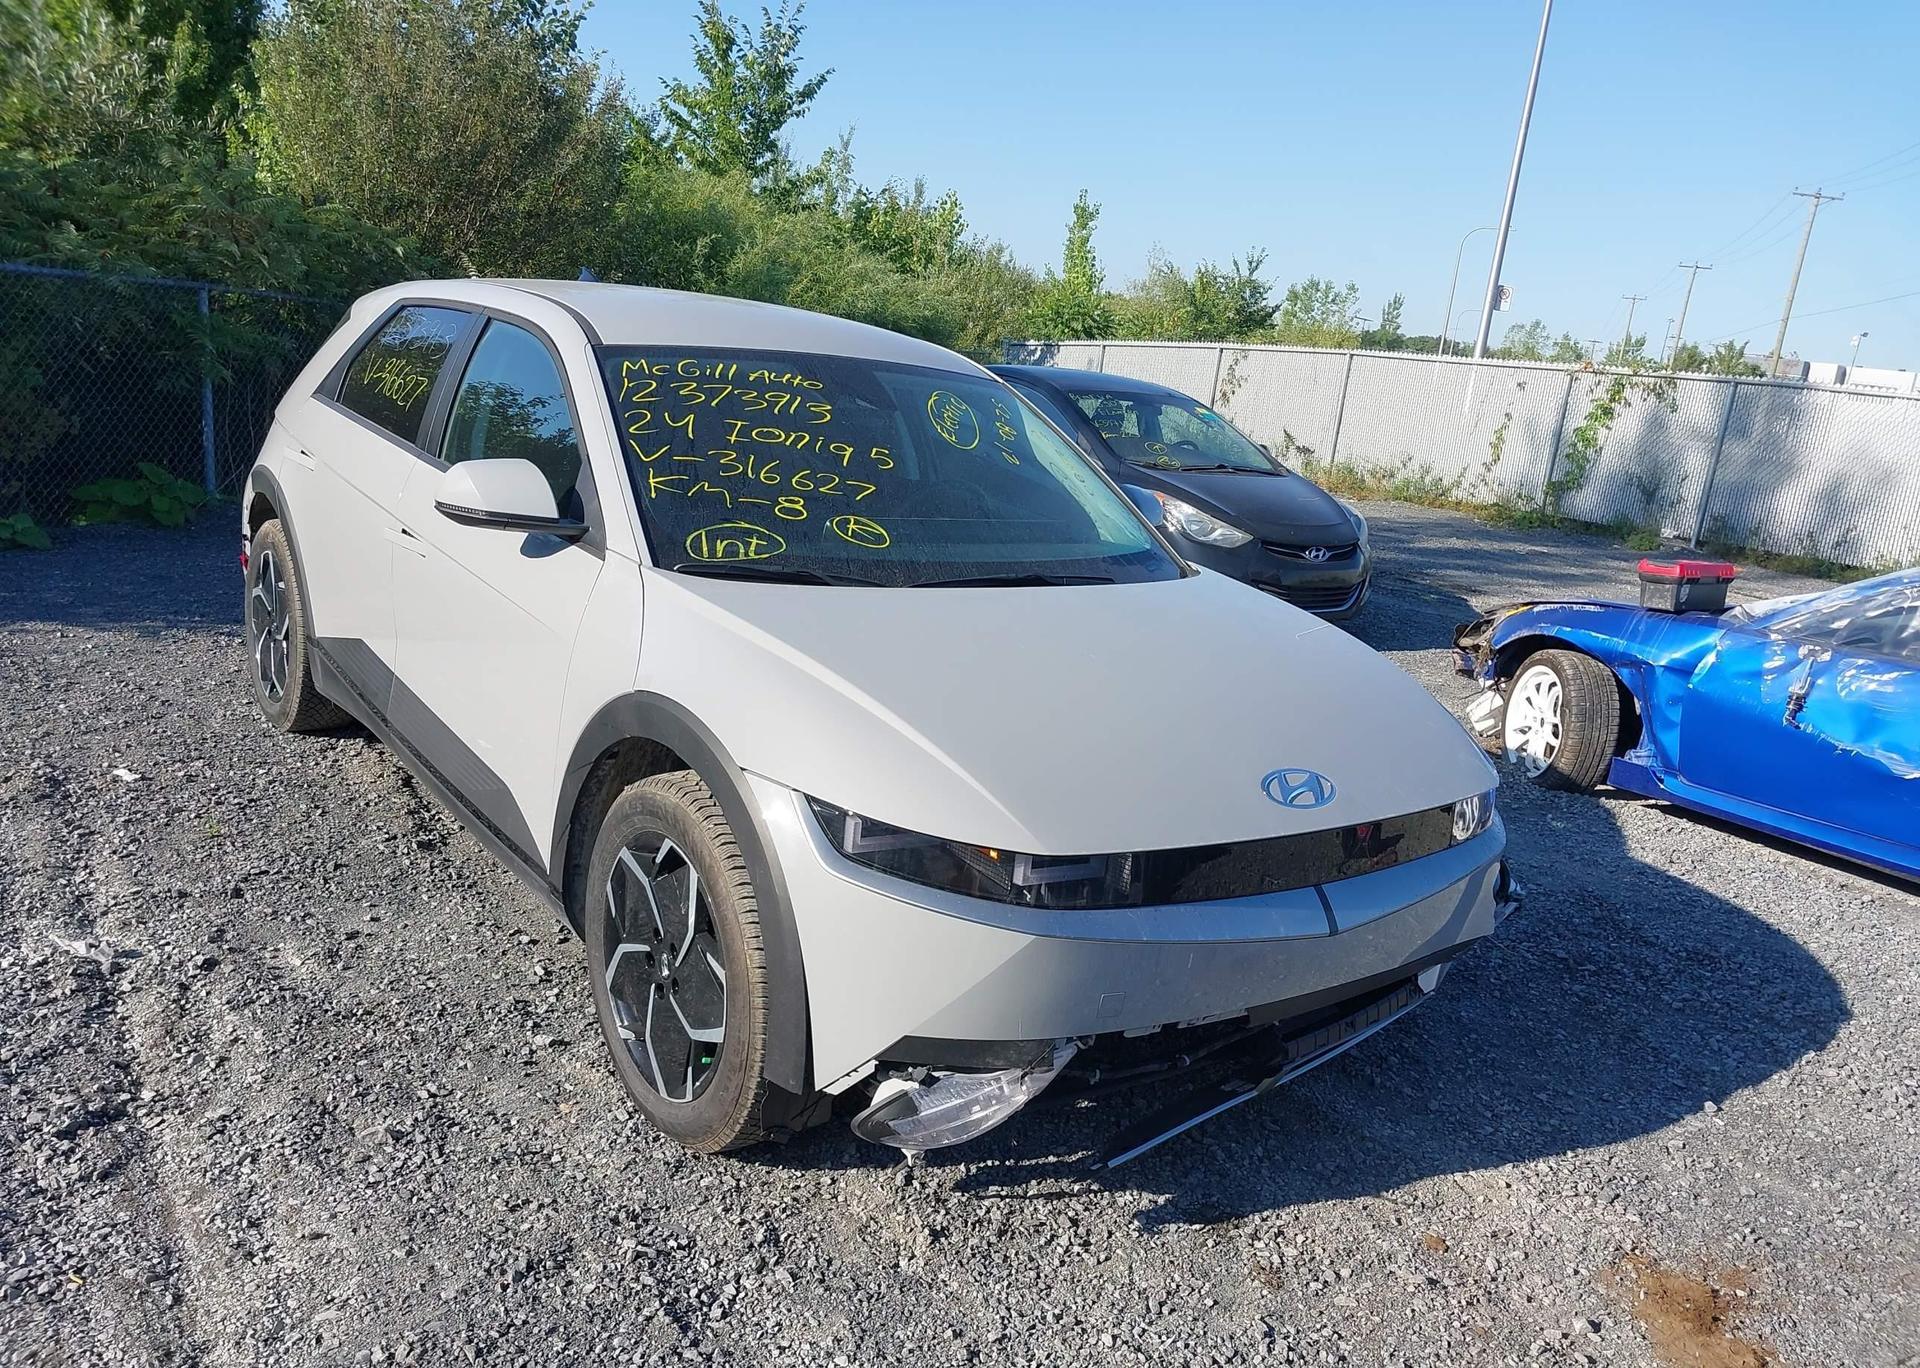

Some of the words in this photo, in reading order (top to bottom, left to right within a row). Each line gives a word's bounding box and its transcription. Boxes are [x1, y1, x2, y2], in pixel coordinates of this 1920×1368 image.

[619, 377, 833, 424] 12373913
[624, 409, 695, 440] 24
[870, 447, 895, 469] 5
